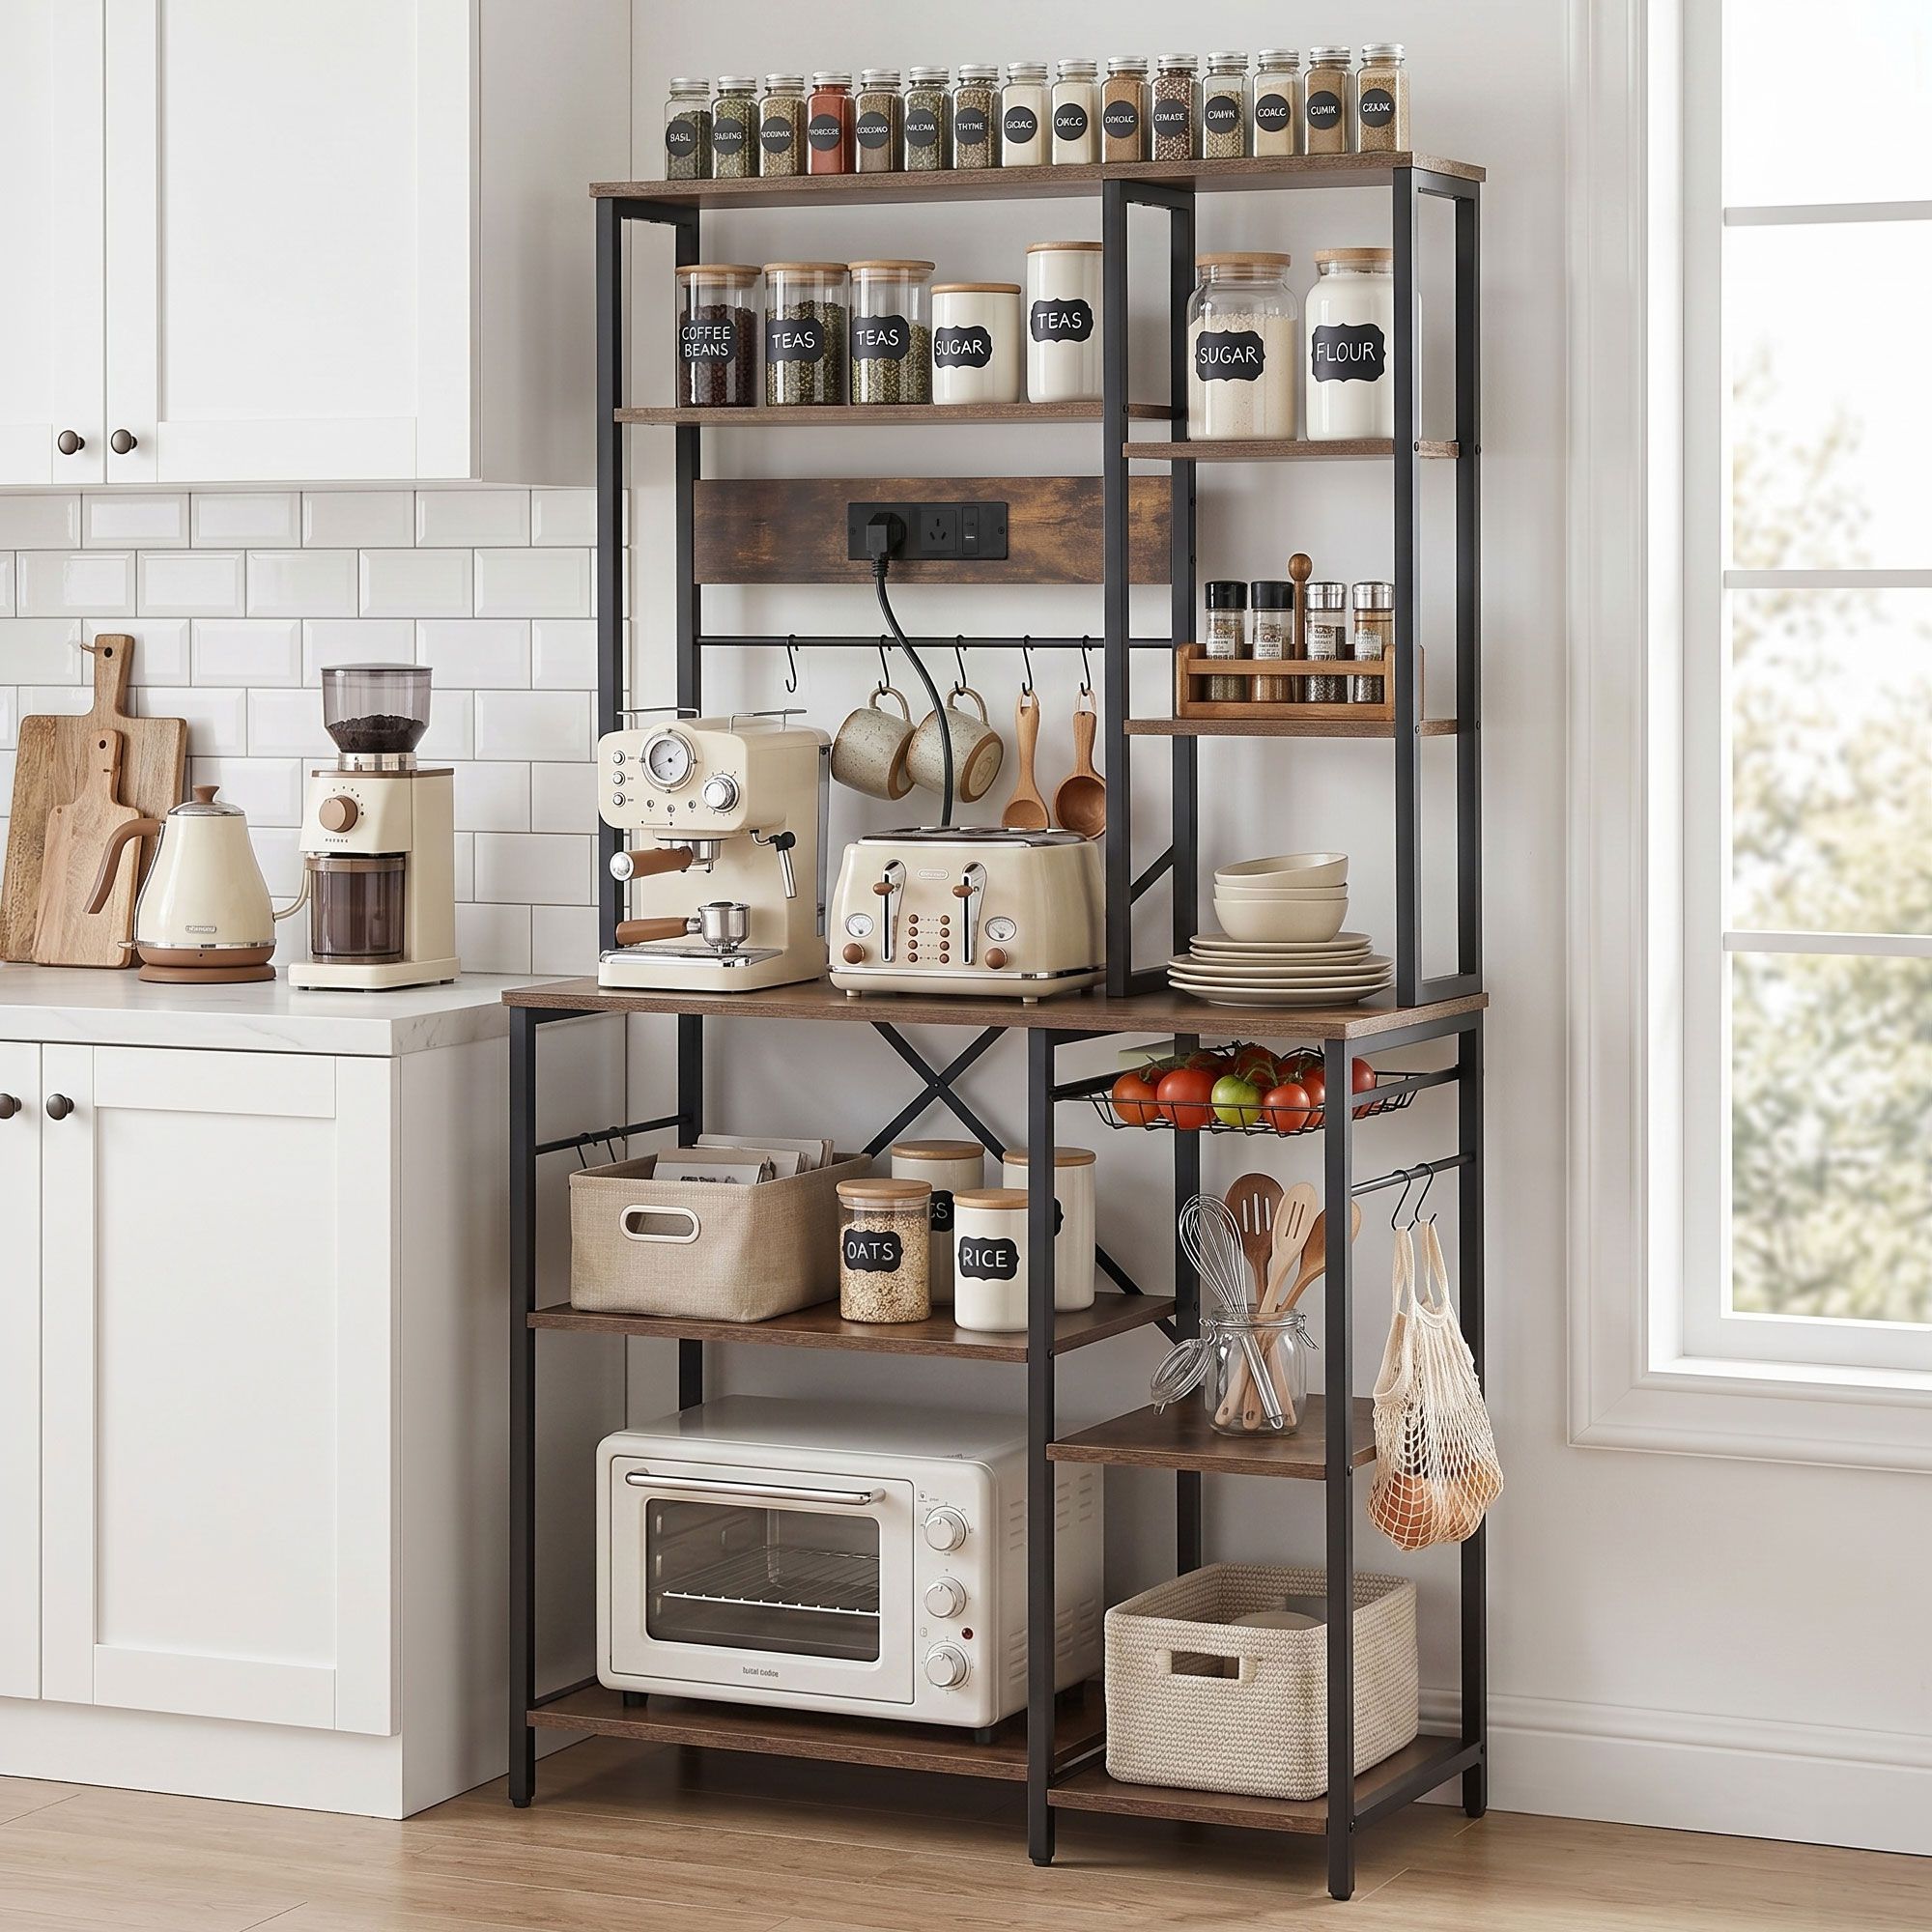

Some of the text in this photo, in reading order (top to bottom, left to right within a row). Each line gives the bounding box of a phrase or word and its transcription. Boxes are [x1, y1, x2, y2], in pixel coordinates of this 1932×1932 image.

[957, 122, 984, 130] THYME
[669, 132, 691, 143] BASIL
[1037, 312, 1083, 329] TEAS
[681, 326, 731, 340] COFFEE
[772, 331, 815, 349] TEAS
[856, 329, 899, 347] TEAS
[684, 343, 728, 357] BEANS
[935, 339, 984, 355] SUGAR
[1199, 346, 1259, 364] SUGAR
[1316, 342, 1376, 362] FLOUR
[846, 1242, 895, 1262] OATS
[962, 1249, 1008, 1268] RICE
